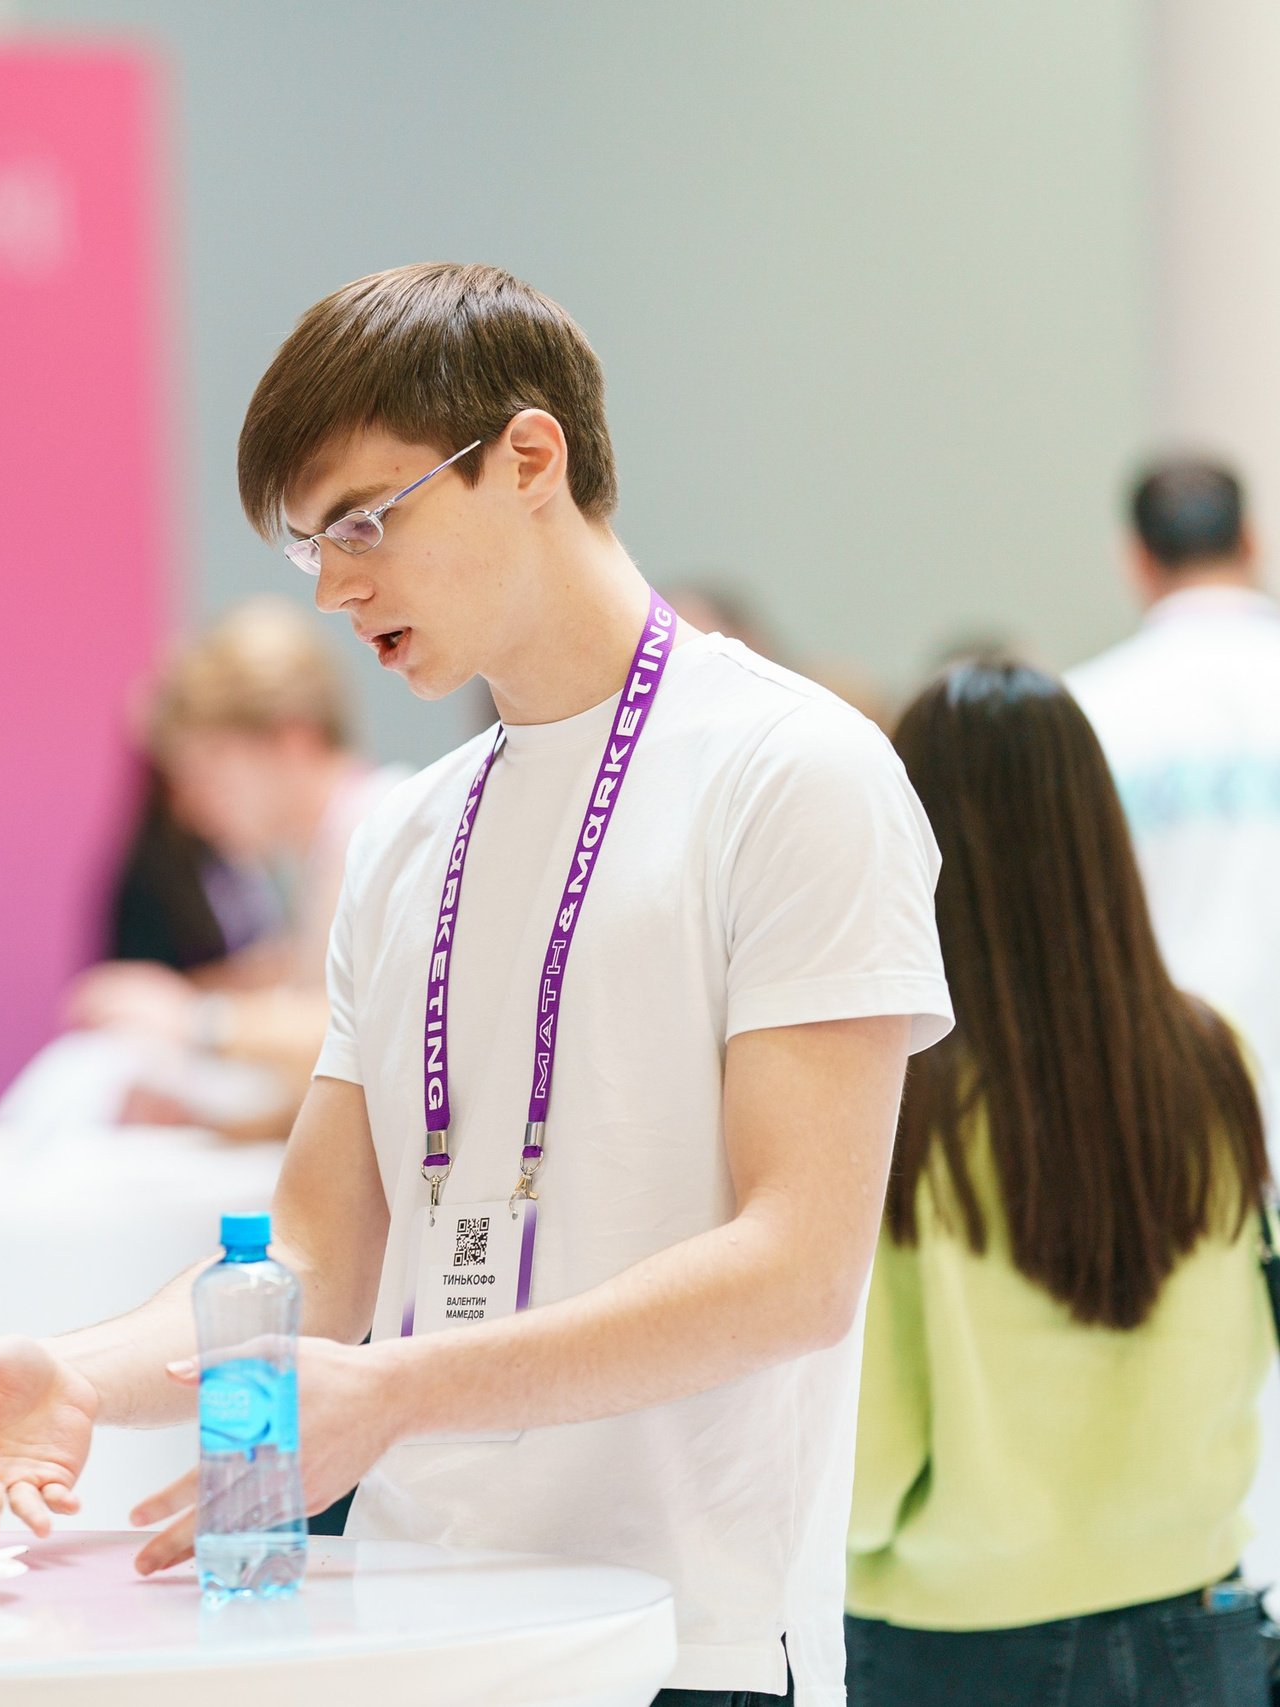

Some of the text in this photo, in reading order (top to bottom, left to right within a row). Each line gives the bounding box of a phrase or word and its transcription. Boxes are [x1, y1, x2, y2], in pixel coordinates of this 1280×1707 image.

[534, 940, 567, 1099] MATH
[558, 900, 579, 933] &
[442, 1274, 496, 1286] ТИНЬКОФФ
[446, 1296, 487, 1306] ВАЛЕНТИН
[445, 1309, 485, 1321] МАМЕДОВ
